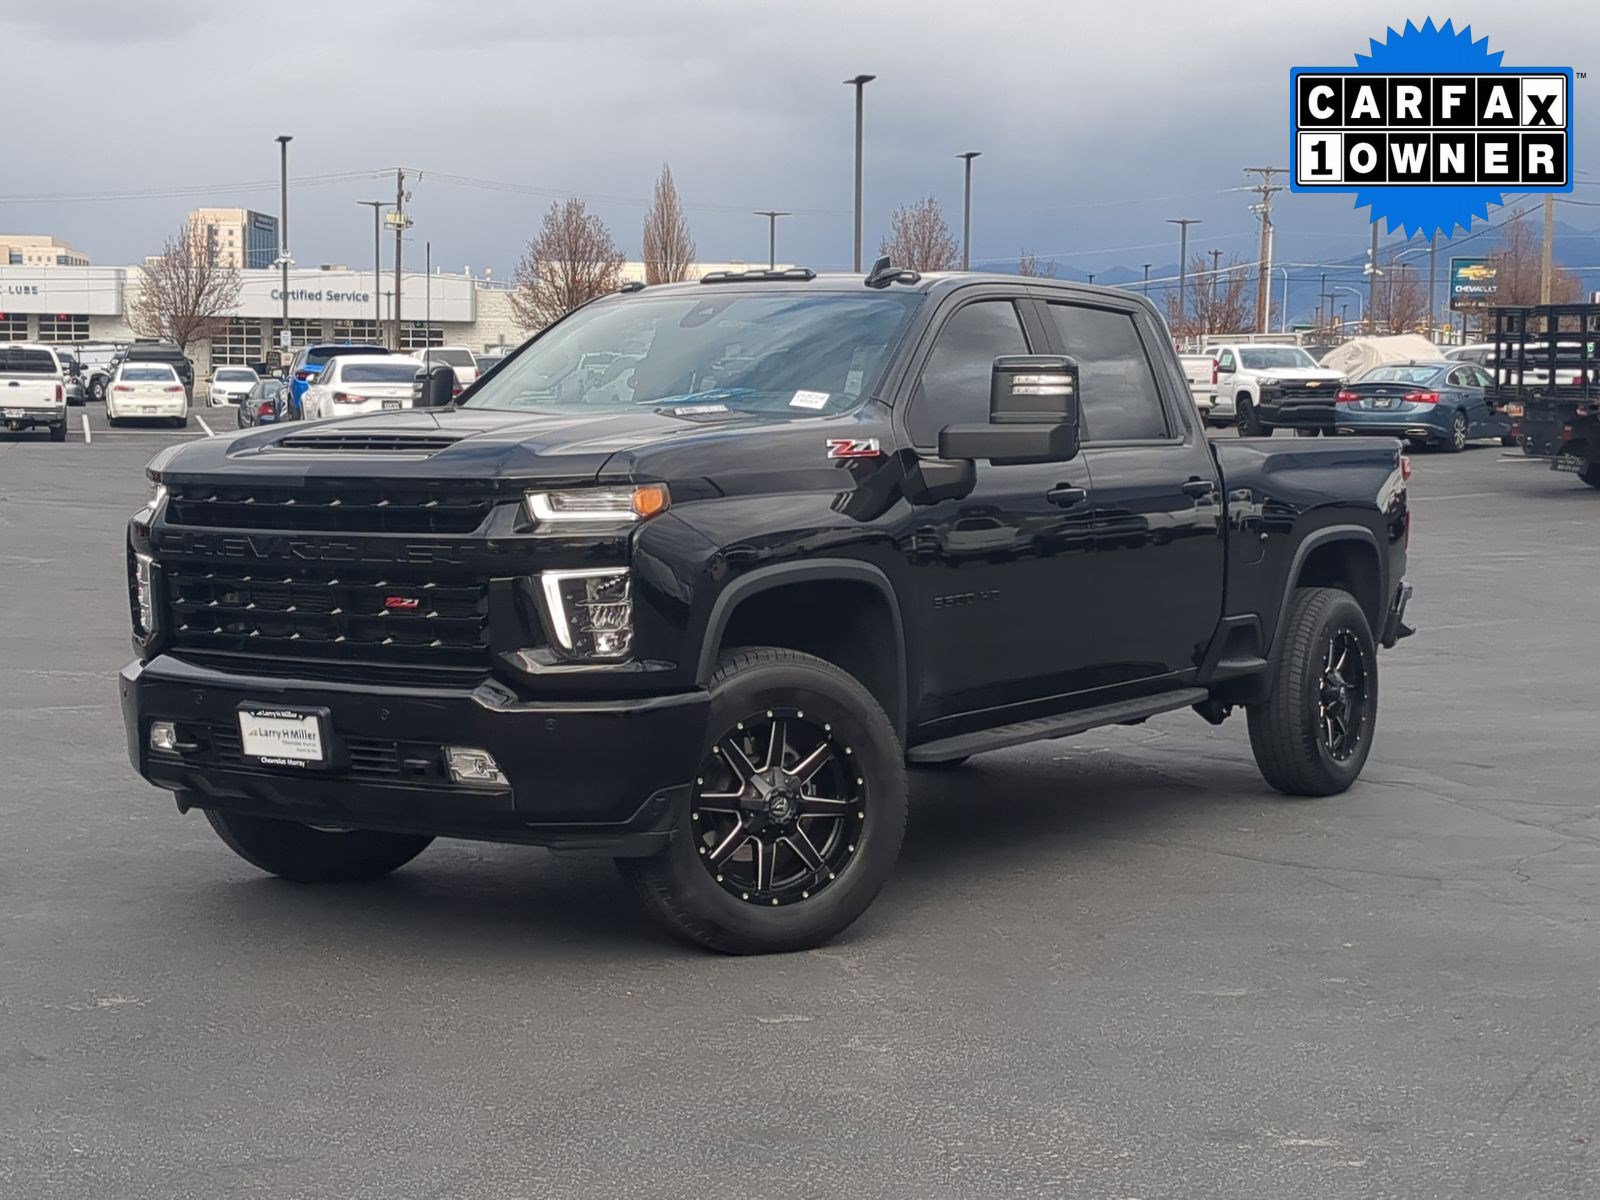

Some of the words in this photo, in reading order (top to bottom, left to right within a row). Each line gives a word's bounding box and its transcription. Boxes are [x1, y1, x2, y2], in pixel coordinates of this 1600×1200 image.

[8, 285, 38, 295] LUBE
[270, 288, 322, 301] Certified
[326, 290, 370, 302] Service
[826, 438, 880, 459] Z71
[384, 596, 420, 609] Z71
[259, 727, 281, 740] Larry
[282, 729, 290, 739] H
[290, 729, 316, 740] Miller
